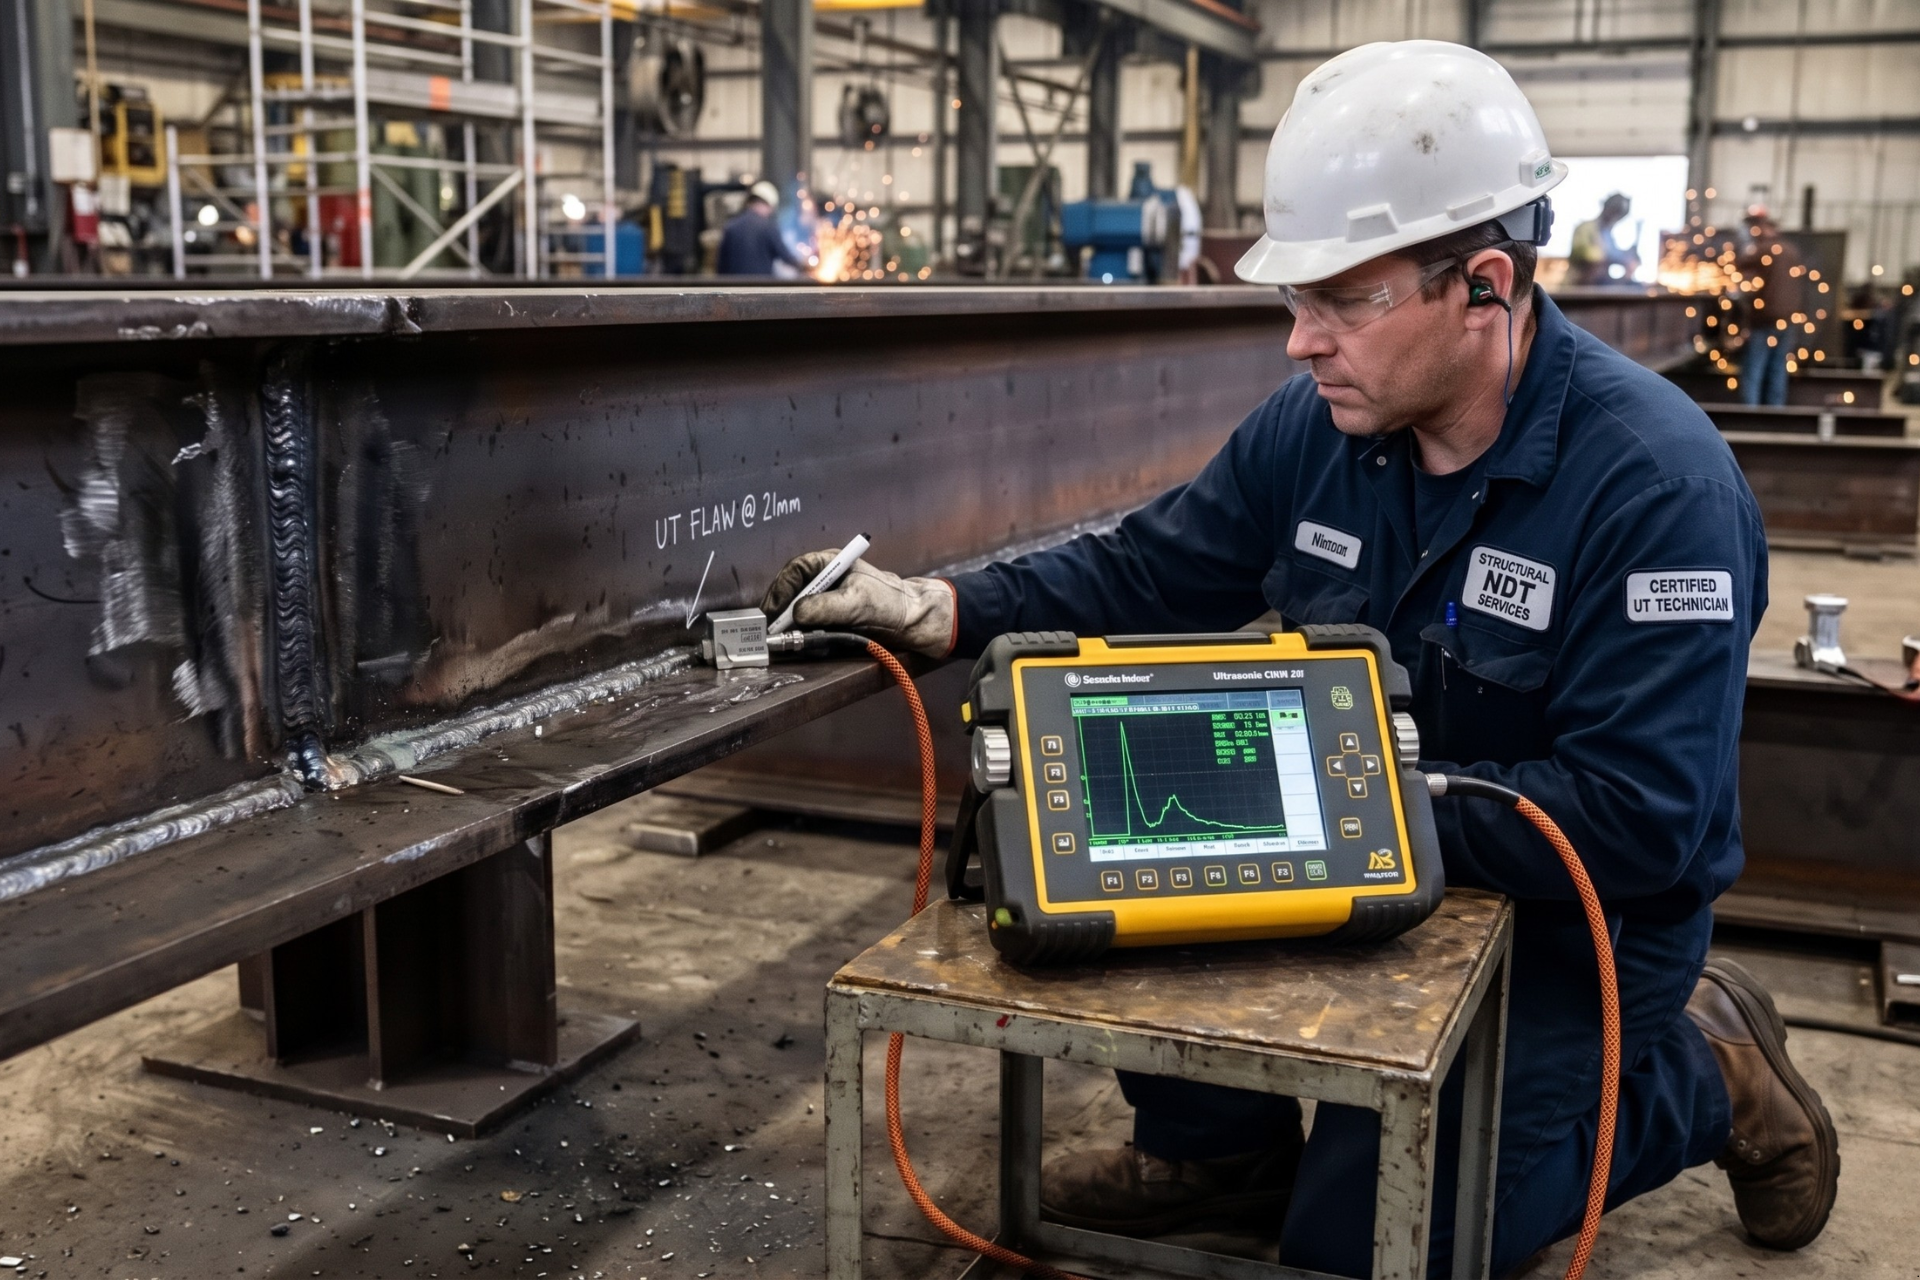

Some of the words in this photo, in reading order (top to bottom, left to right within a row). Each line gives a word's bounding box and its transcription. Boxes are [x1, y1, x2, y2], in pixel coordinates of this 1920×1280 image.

[655, 513, 682, 550] UT
[690, 499, 736, 541] FLAW
[741, 493, 757, 528] @
[1478, 552, 1550, 585] STRUCTURAL
[1482, 569, 1537, 605] NDT
[1649, 578, 1717, 594] CERTIFIED
[1477, 593, 1531, 621] SERVICES
[1633, 598, 1651, 613] UT
[1655, 597, 1729, 612] TECHNICIAN
[1106, 876, 1119, 886] F1
[1141, 875, 1153, 884] F2
[1175, 873, 1188, 882] F3
